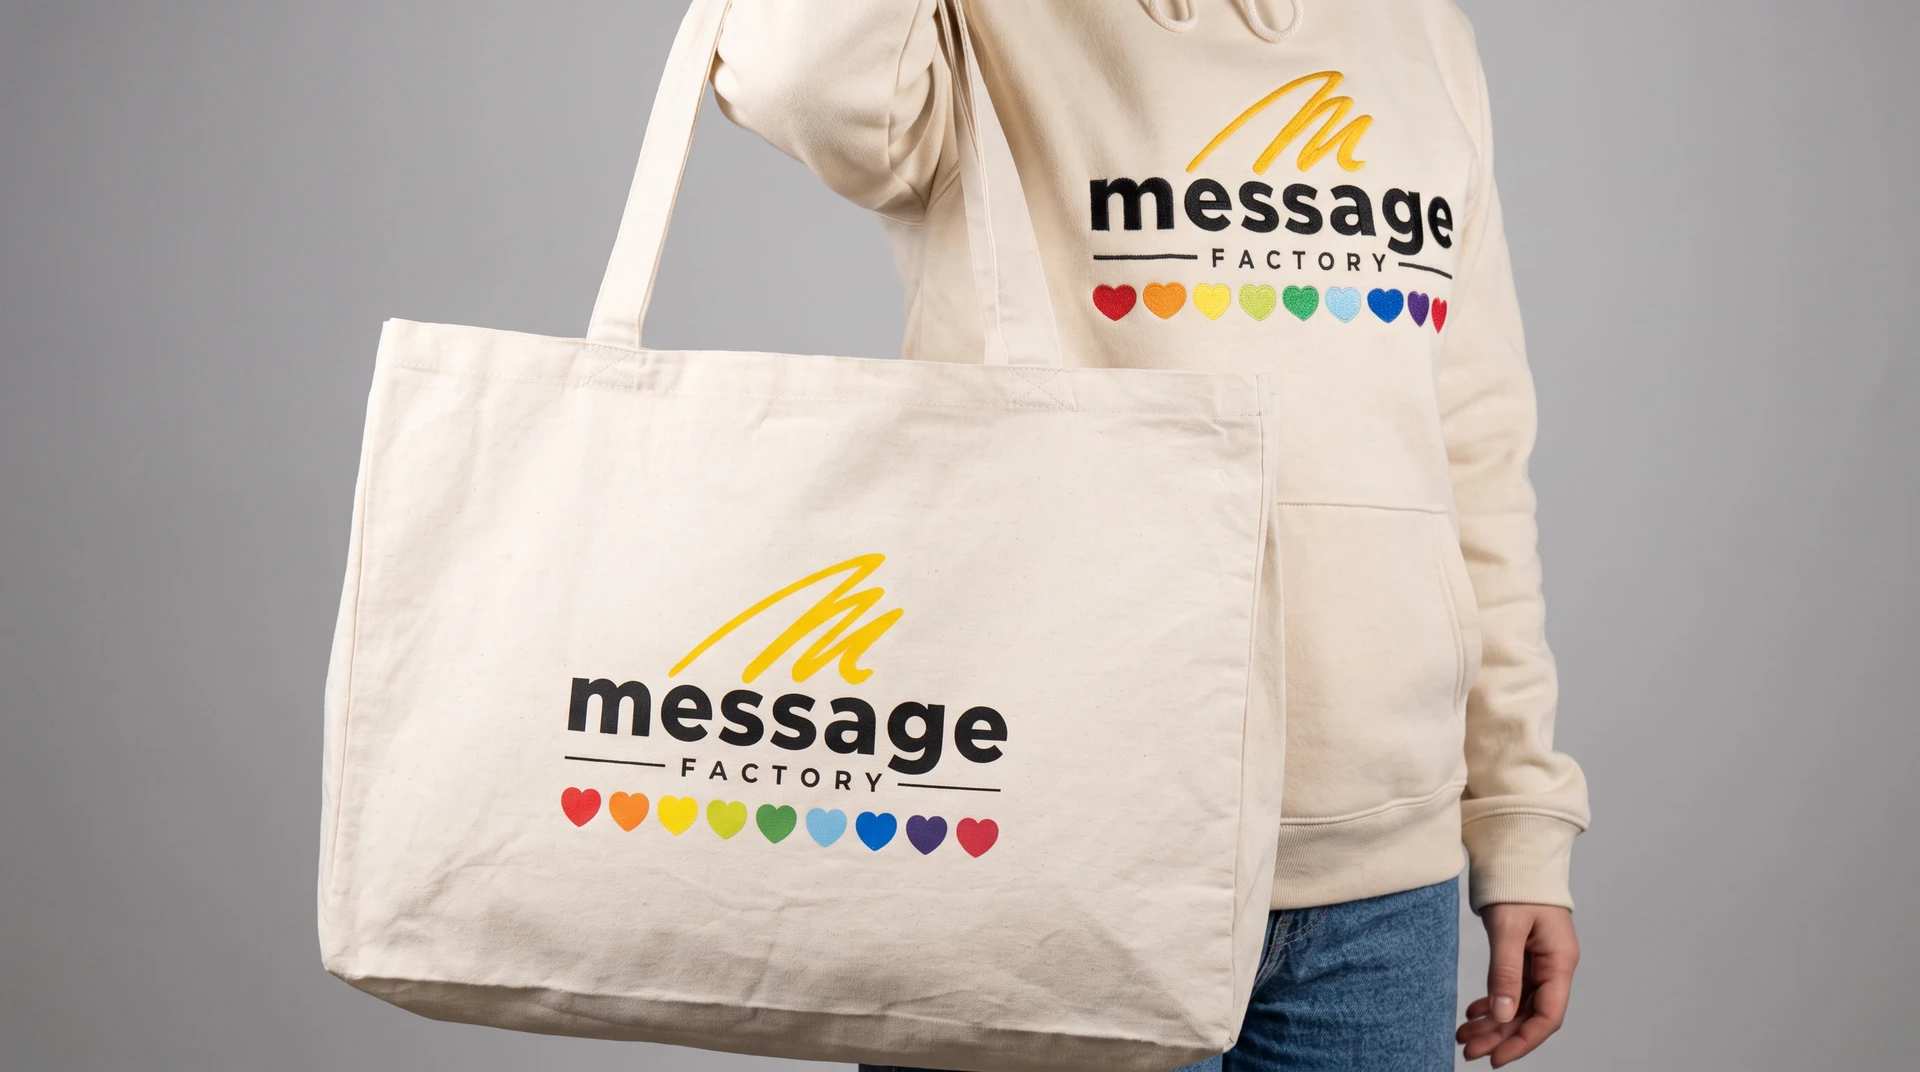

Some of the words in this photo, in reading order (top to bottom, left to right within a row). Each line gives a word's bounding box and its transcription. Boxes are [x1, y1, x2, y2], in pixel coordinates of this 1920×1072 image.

[1089, 176, 1454, 256] message
[1211, 248, 1387, 273] FACTORY
[567, 677, 1009, 775] message
[680, 757, 884, 793] FACTORY
